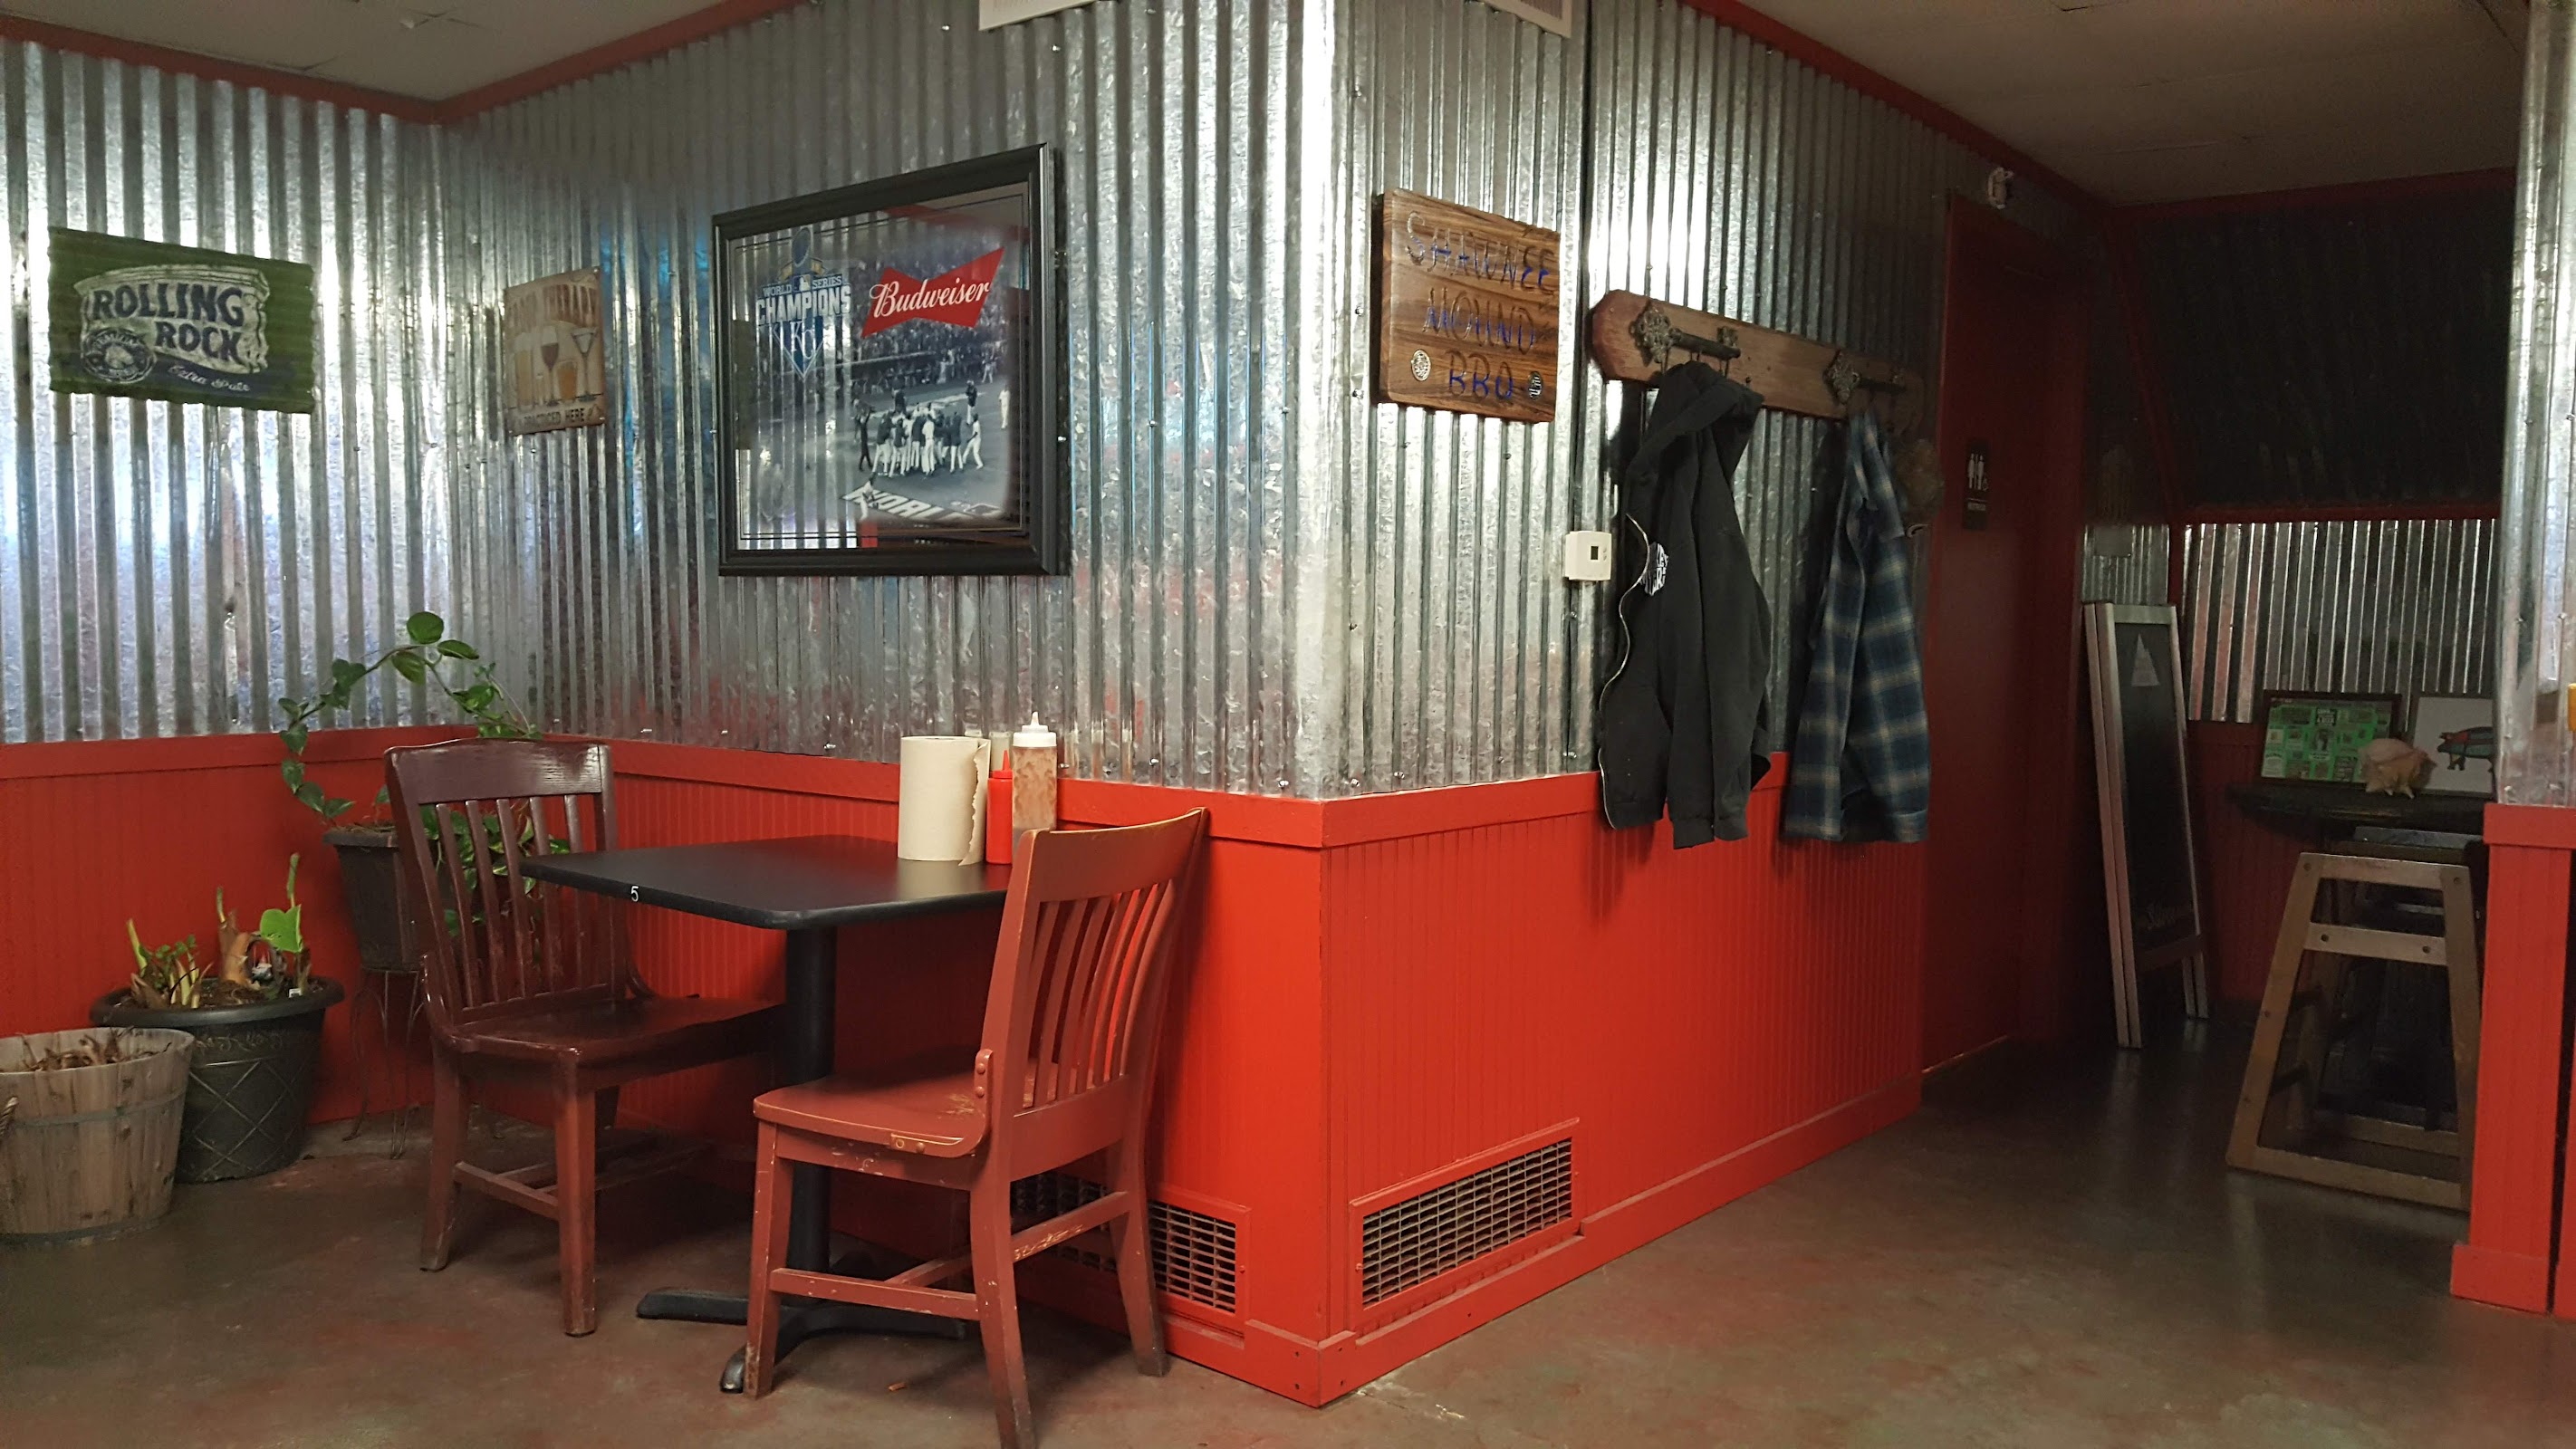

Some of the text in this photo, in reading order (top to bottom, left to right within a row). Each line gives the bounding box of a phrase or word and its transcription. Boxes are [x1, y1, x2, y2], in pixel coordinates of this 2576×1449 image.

[1406, 210, 1554, 296] SHAWNEE
[93, 282, 244, 327] ROLLING
[755, 284, 851, 325] CHAMPIONS
[763, 275, 842, 297] WORLD SERIES
[869, 276, 990, 318] Budweiser
[1422, 286, 1535, 355] MOUND
[155, 321, 243, 364] ROCK
[630, 885, 639, 902] 5
